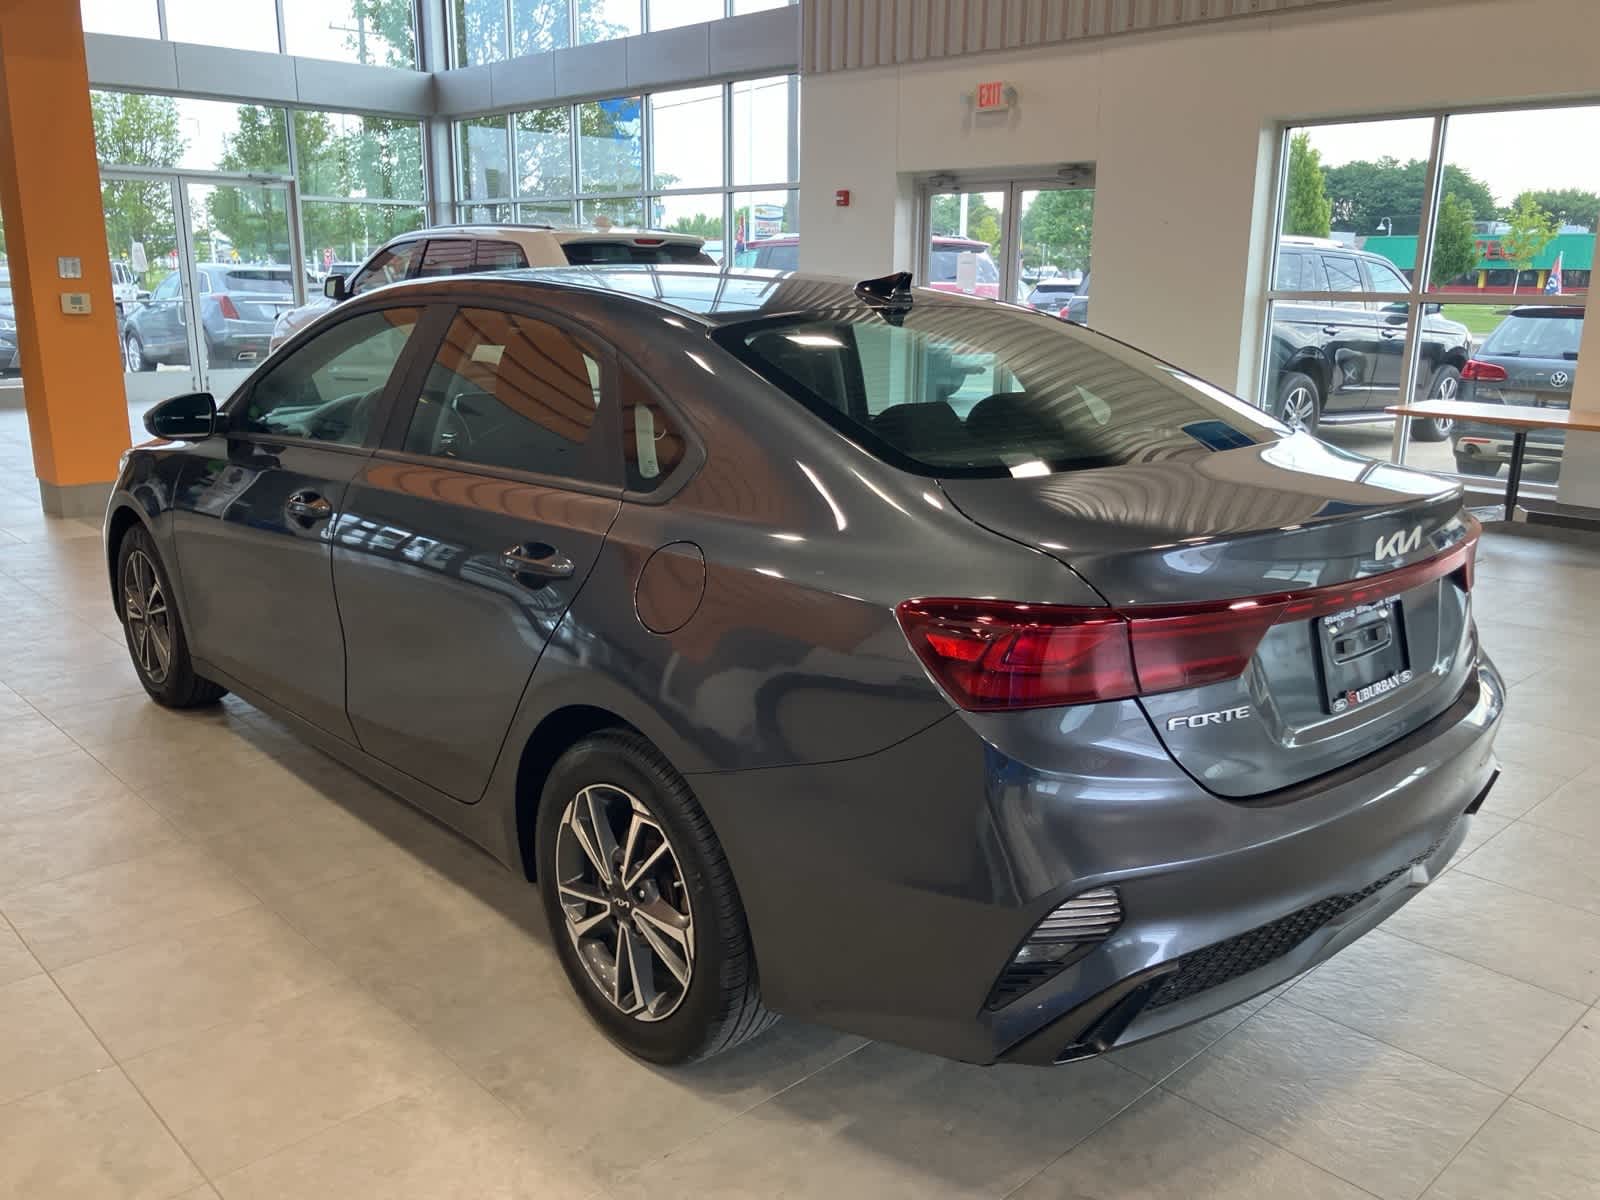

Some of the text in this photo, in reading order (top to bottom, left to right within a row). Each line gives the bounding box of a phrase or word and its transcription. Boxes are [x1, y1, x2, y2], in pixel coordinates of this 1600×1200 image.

[978, 82, 1002, 107] EXIT
[1375, 525, 1422, 561] KIA
[1347, 673, 1400, 707] SUBURBAN
[1167, 705, 1250, 731] FORTE
